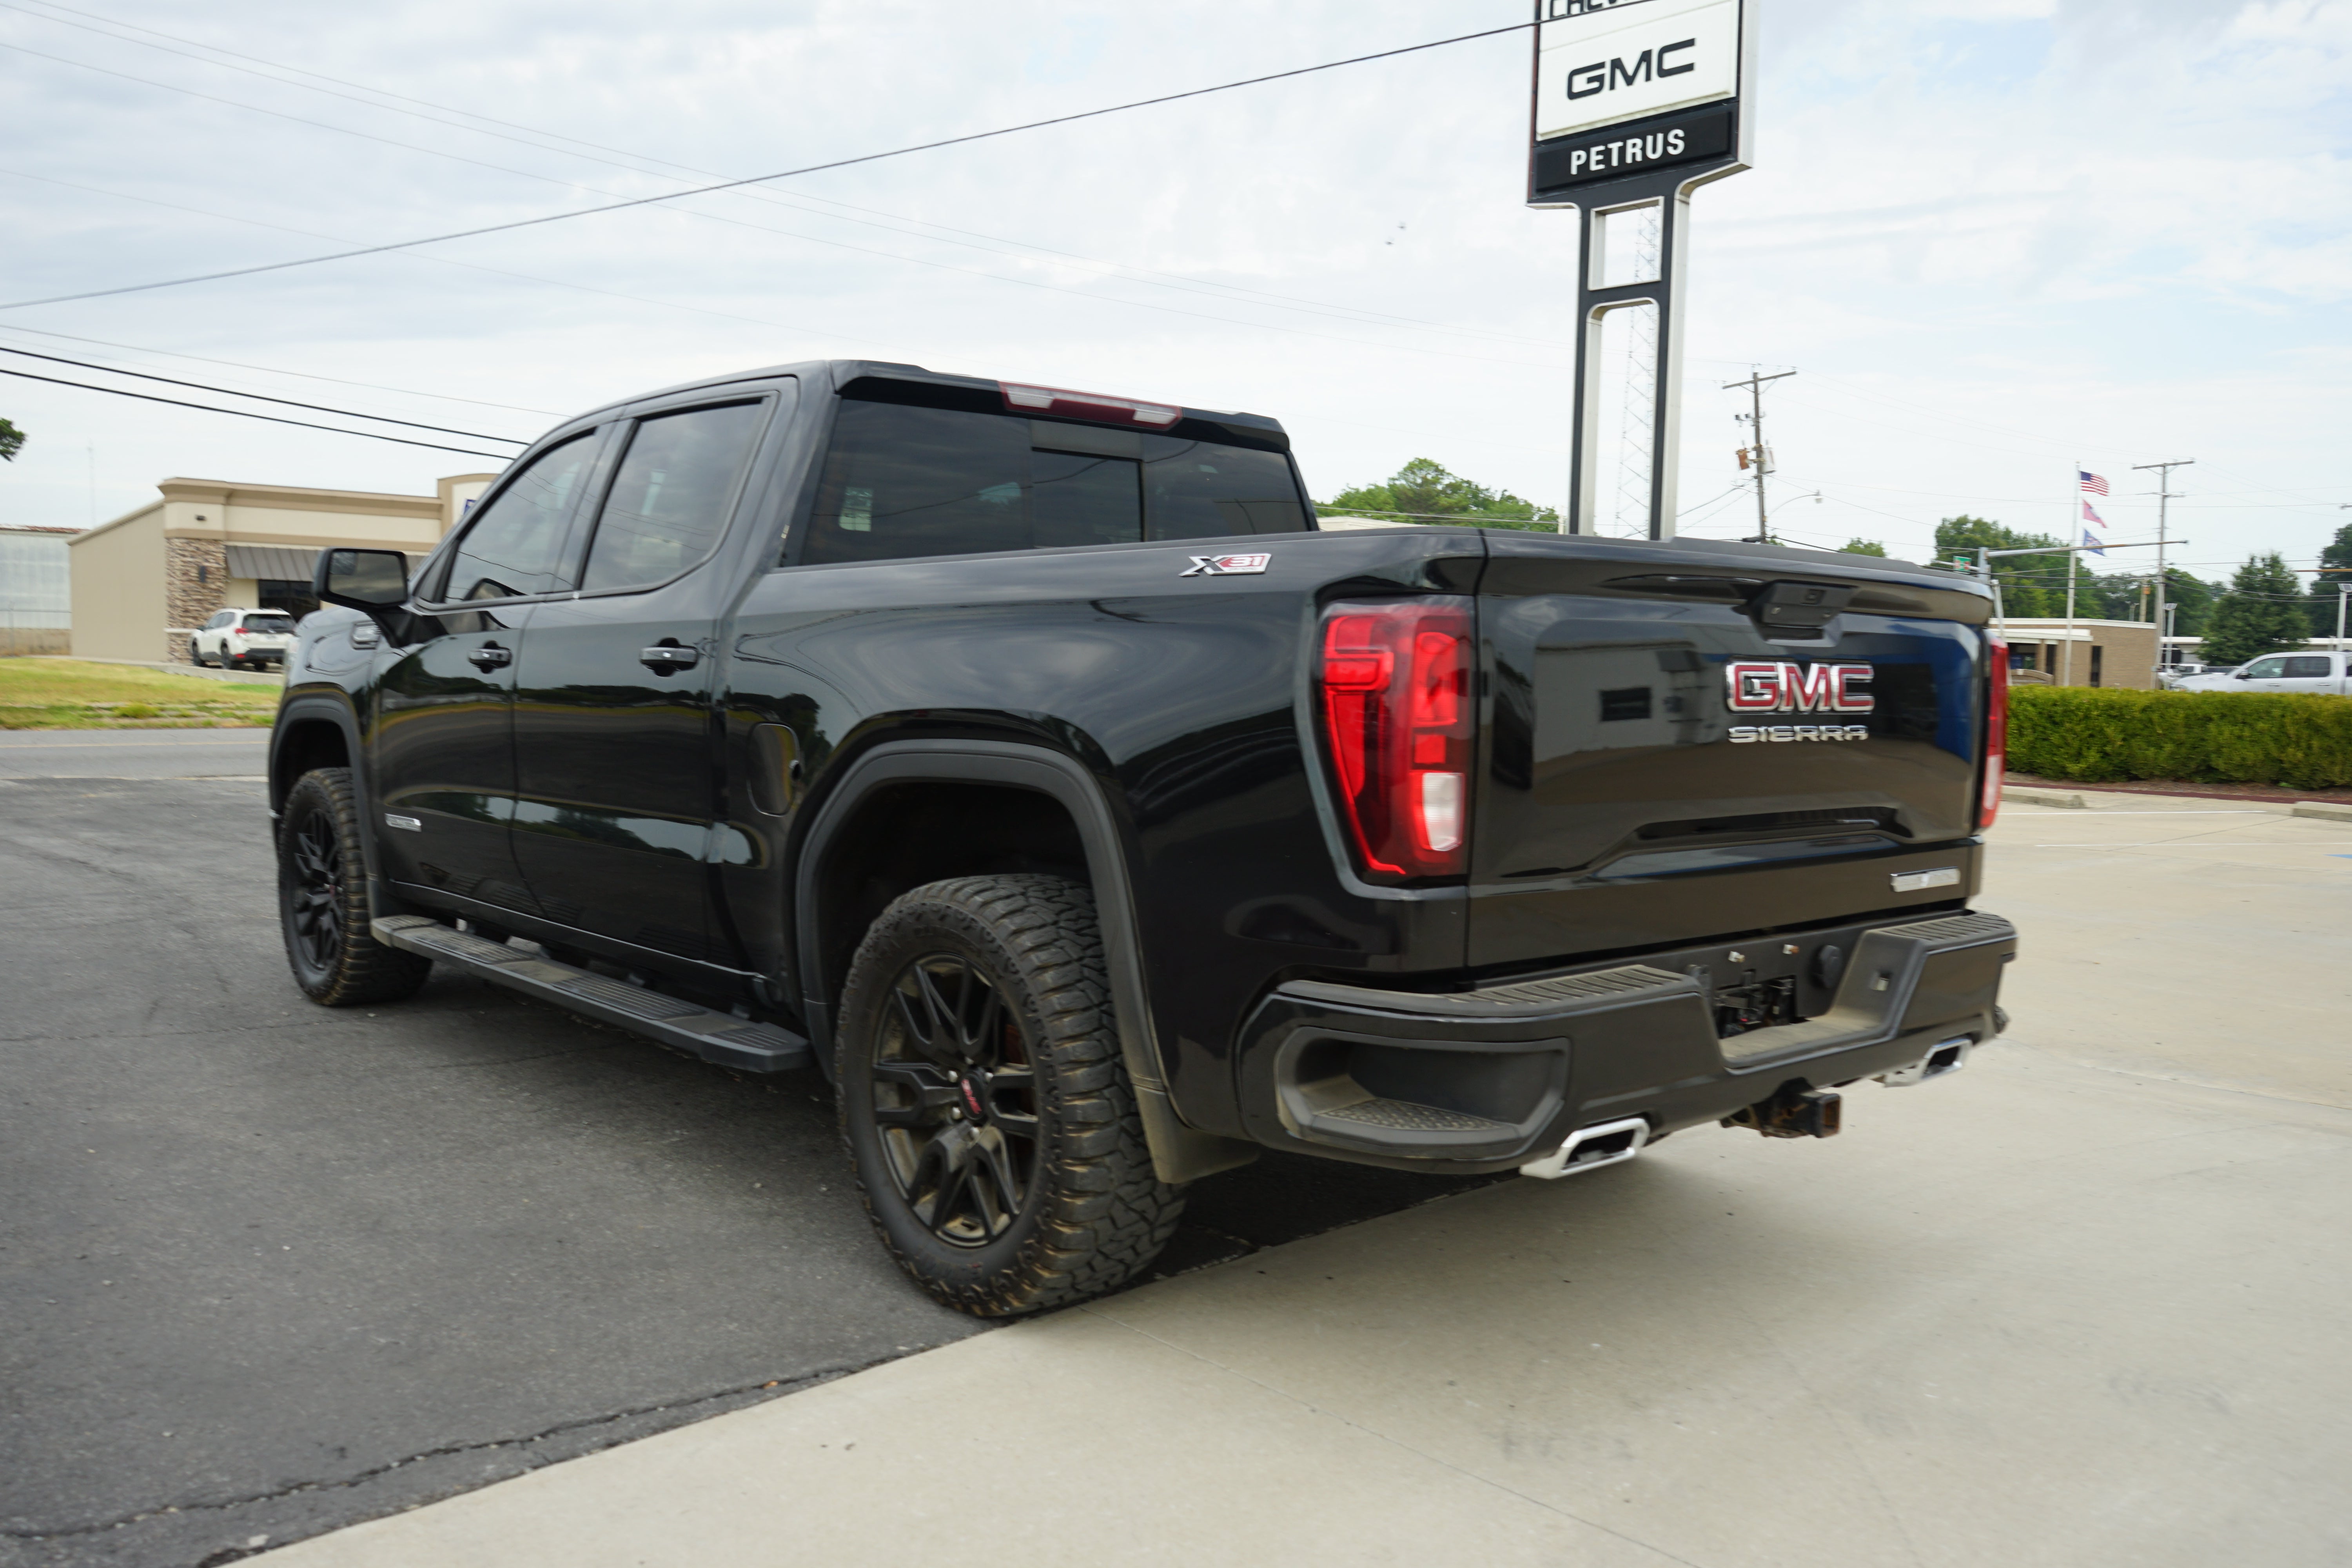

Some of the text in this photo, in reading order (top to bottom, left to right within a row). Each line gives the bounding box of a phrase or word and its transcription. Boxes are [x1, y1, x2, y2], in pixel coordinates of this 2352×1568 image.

[1567, 38, 1695, 100] GMC
[1570, 129, 1685, 175] PETRUS
[1178, 553, 1272, 577] X31
[1726, 661, 1874, 713] GMC
[1728, 725, 1868, 742] SIERRA
